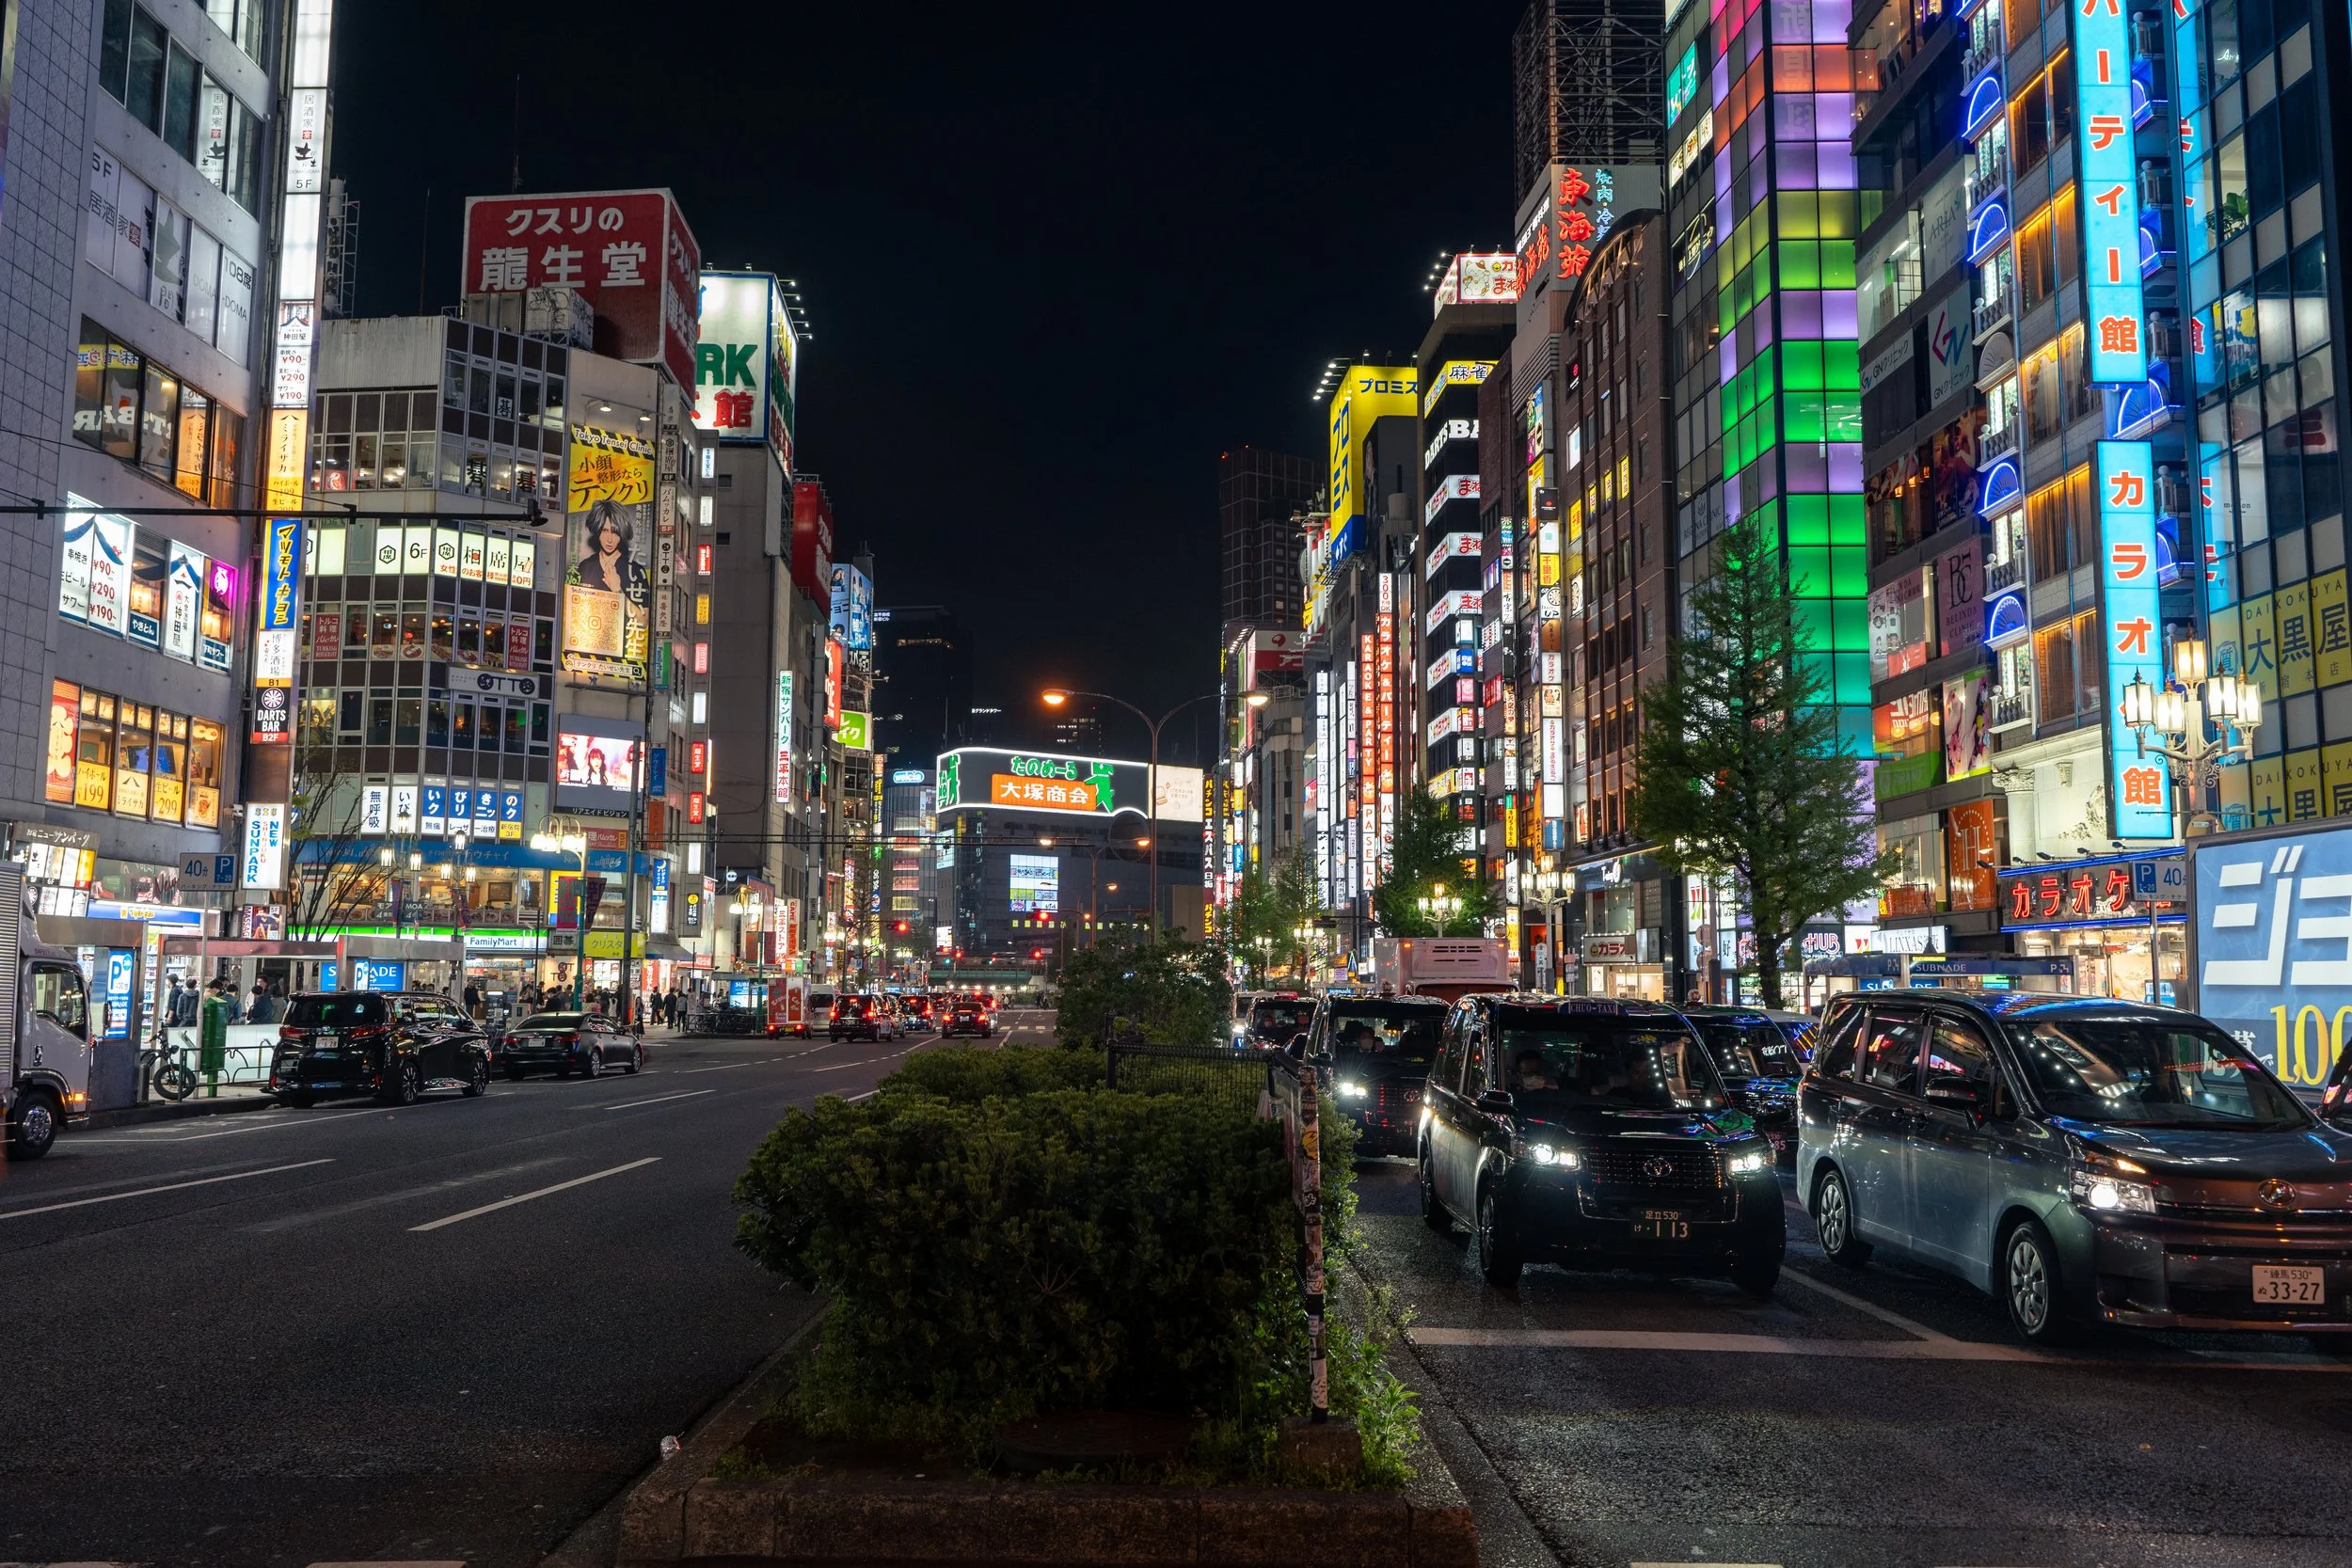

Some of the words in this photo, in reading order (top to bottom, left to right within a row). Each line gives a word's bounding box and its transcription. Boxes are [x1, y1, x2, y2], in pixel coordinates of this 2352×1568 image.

[302, 94, 315, 128] 居酒家
[91, 154, 112, 179] 5F
[295, 180, 312, 189] 5F
[89, 190, 129, 237] 居酒家
[505, 206, 625, 237] クスリの
[224, 256, 253, 290] 108席
[479, 240, 647, 293] 龍生堂
[1449, 364, 1488, 380] 麻雀
[1359, 377, 1418, 394] プロミス
[575, 427, 600, 446] Tokyo
[601, 436, 628, 450] Tensei
[629, 440, 652, 454] Clinic
[1423, 420, 1449, 470] DARTS
[579, 453, 613, 475] 小顔
[596, 466, 643, 485] 整形なら
[570, 478, 649, 509] テンクリ
[661, 488, 672, 523] パムッカレ
[409, 542, 428, 560] 6F
[463, 545, 533, 574] 相席屋
[62, 594, 86, 609] サワー
[91, 581, 115, 600] ¥290
[625, 545, 647, 660] たいせい先生
[2246, 579, 2343, 621] DAIKOKUYA
[318, 617, 339, 626] トルコ
[511, 628, 529, 637] トルコ
[2108, 470, 2163, 806] カラオ館
[2248, 602, 2350, 676] 大黒屋
[576, 660, 596, 670] テンクリ
[598, 663, 630, 673] たいせい先生
[257, 708, 286, 721] DARTS
[780, 675, 792, 744] 新宿サンパーク
[262, 721, 280, 733] BAR
[262, 733, 279, 742] B2F
[777, 751, 789, 799] 三平本館
[1010, 755, 1078, 781] たのめーる
[1000, 782, 1089, 804] 大塚商会
[1204, 779, 1214, 816] パチンコ
[368, 790, 382, 828] 無呼吸
[260, 821, 268, 863] SHINJUKU
[269, 820, 279, 847] NEW
[246, 820, 261, 883] SUNPARK
[1365, 808, 1374, 888] PASELA
[184, 860, 209, 879] 40分
[220, 857, 230, 874] P
[2140, 867, 2152, 882] P
[2011, 868, 2130, 920] カラオケ
[1204, 903, 1213, 934] パチンコ
[469, 937, 517, 948] FamilyMart
[1804, 932, 1840, 955] HUB
[1915, 963, 1967, 973] SUBNADE
[1645, 1210, 1662, 1220] 足立
[1663, 1210, 1679, 1220] 530
[1634, 1224, 1642, 1232] け
[2290, 1270, 2309, 1280] 530
[2269, 1281, 2320, 1301] 33-27
